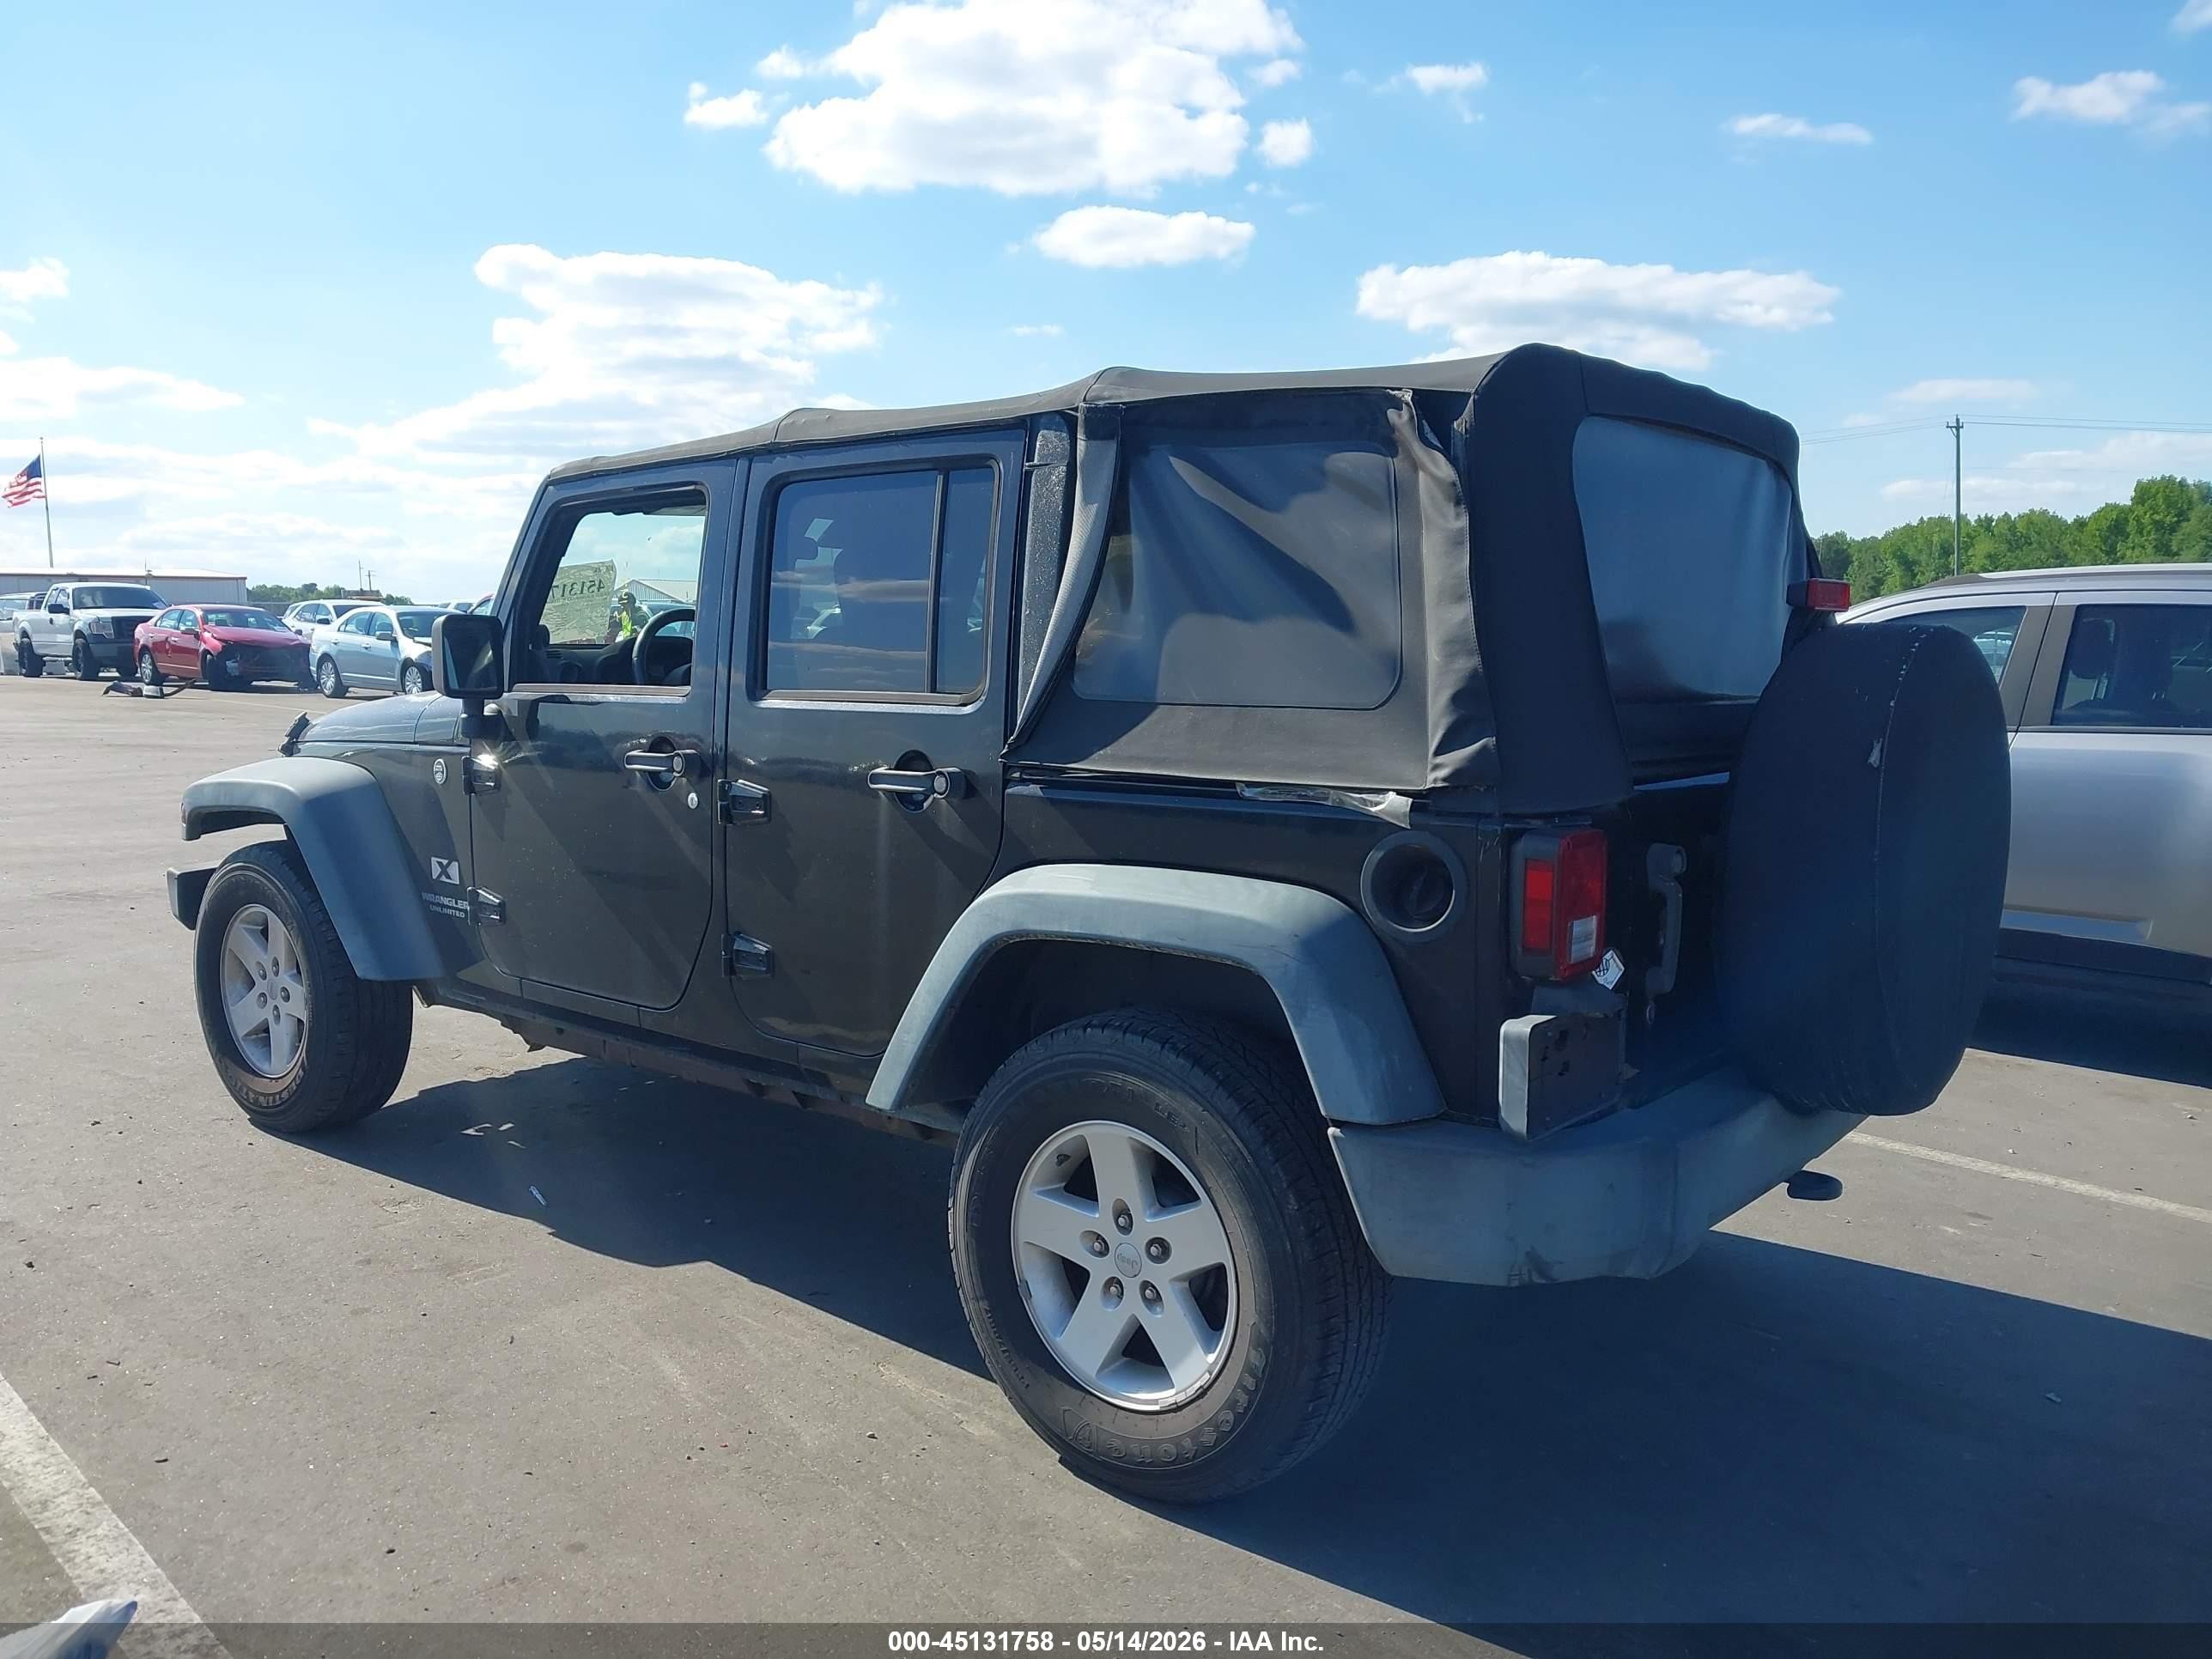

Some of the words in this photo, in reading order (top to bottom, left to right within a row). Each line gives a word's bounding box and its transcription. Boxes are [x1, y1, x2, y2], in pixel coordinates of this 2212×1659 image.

[433, 858, 456, 882] X
[422, 891, 469, 910] WRANGLER
[429, 904, 465, 918] UNLIMITED
